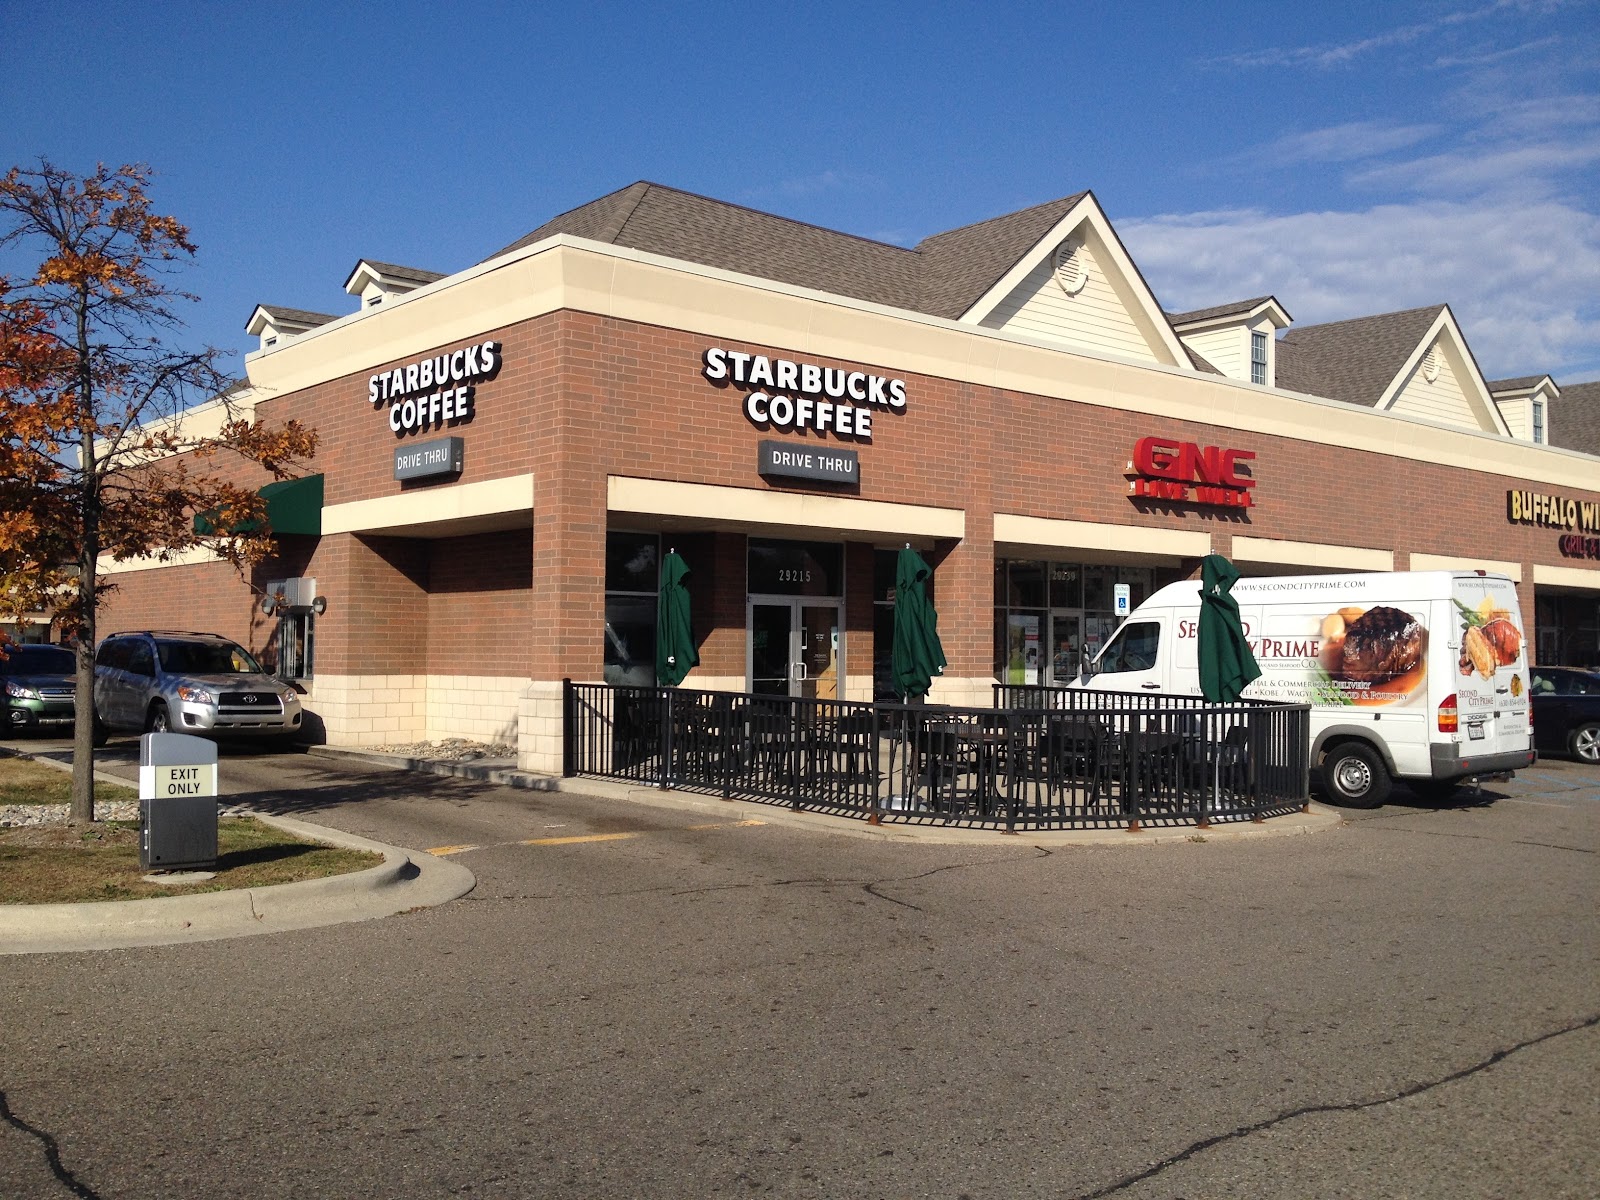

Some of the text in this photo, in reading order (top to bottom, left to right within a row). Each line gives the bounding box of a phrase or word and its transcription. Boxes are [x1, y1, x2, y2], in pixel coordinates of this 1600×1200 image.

[368, 341, 495, 403] STARBUCKS
[706, 347, 906, 407] STARBUCKS
[389, 386, 468, 432] COFFEE
[747, 392, 872, 436] COFFEE
[397, 448, 448, 470] DRIVE THRU
[772, 450, 853, 472] DRIVE THRU
[1134, 437, 1256, 488] GNC
[1135, 479, 1256, 507] LIVE WELL
[1512, 490, 1577, 527] BUFFALO
[779, 569, 811, 582] 29215
[1233, 581, 1366, 591] WWW.SECONDCITYPRIME.COM
[1332, 680, 1372, 690] DELIVERY
[1370, 691, 1409, 700] POULTRY
[1459, 689, 1478, 698] SECOND
[171, 768, 199, 780] EXIT
[168, 782, 200, 795] ONLY
